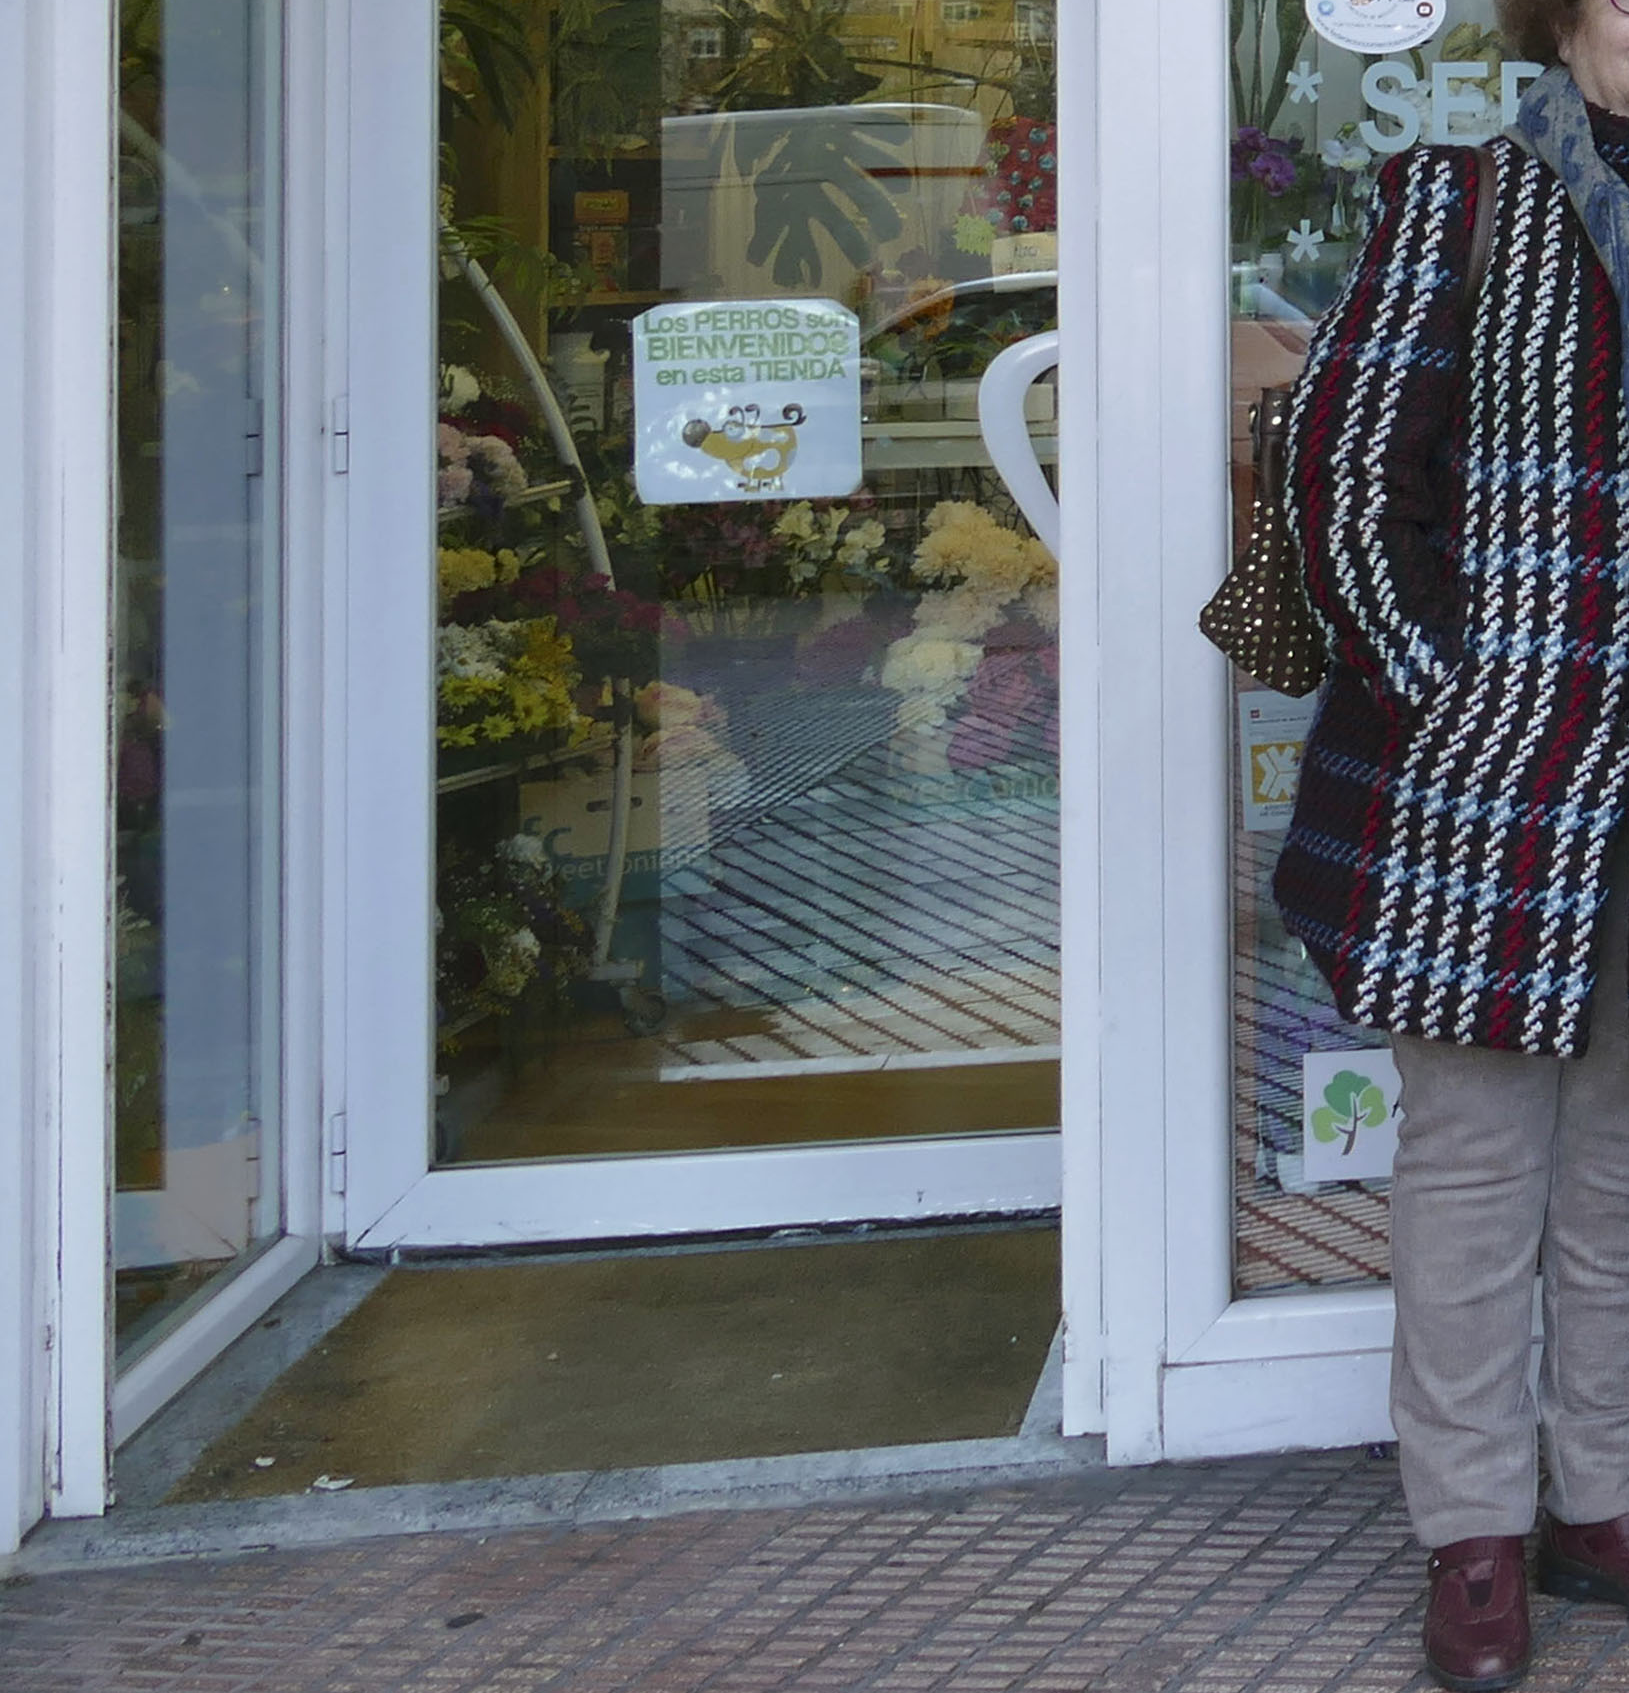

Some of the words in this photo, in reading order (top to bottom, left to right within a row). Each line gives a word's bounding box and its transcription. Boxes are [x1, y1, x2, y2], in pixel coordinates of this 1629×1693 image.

[644, 311, 688, 334] Los
[695, 308, 800, 332] PERROS
[647, 330, 850, 362] BIENVENIDOS
[656, 368, 687, 386] en
[692, 364, 745, 384] esta
[749, 358, 847, 383] TIENDA
